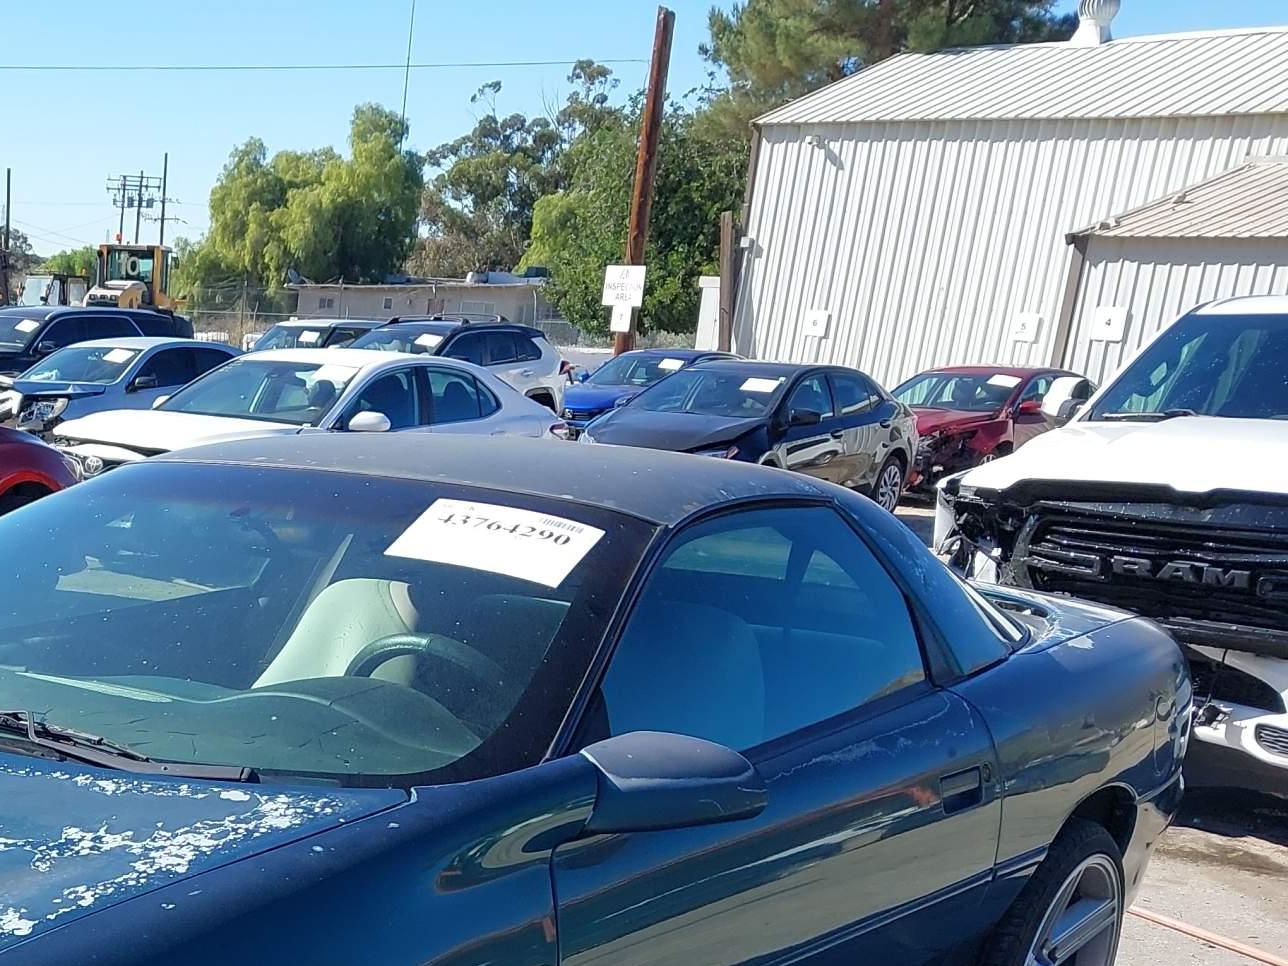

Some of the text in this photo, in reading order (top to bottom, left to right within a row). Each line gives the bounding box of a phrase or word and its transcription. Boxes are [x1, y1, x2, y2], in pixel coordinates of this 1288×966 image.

[605, 282, 642, 292] INSPECON
[438, 513, 571, 546] 43764290
[1112, 555, 1252, 589] RAM
